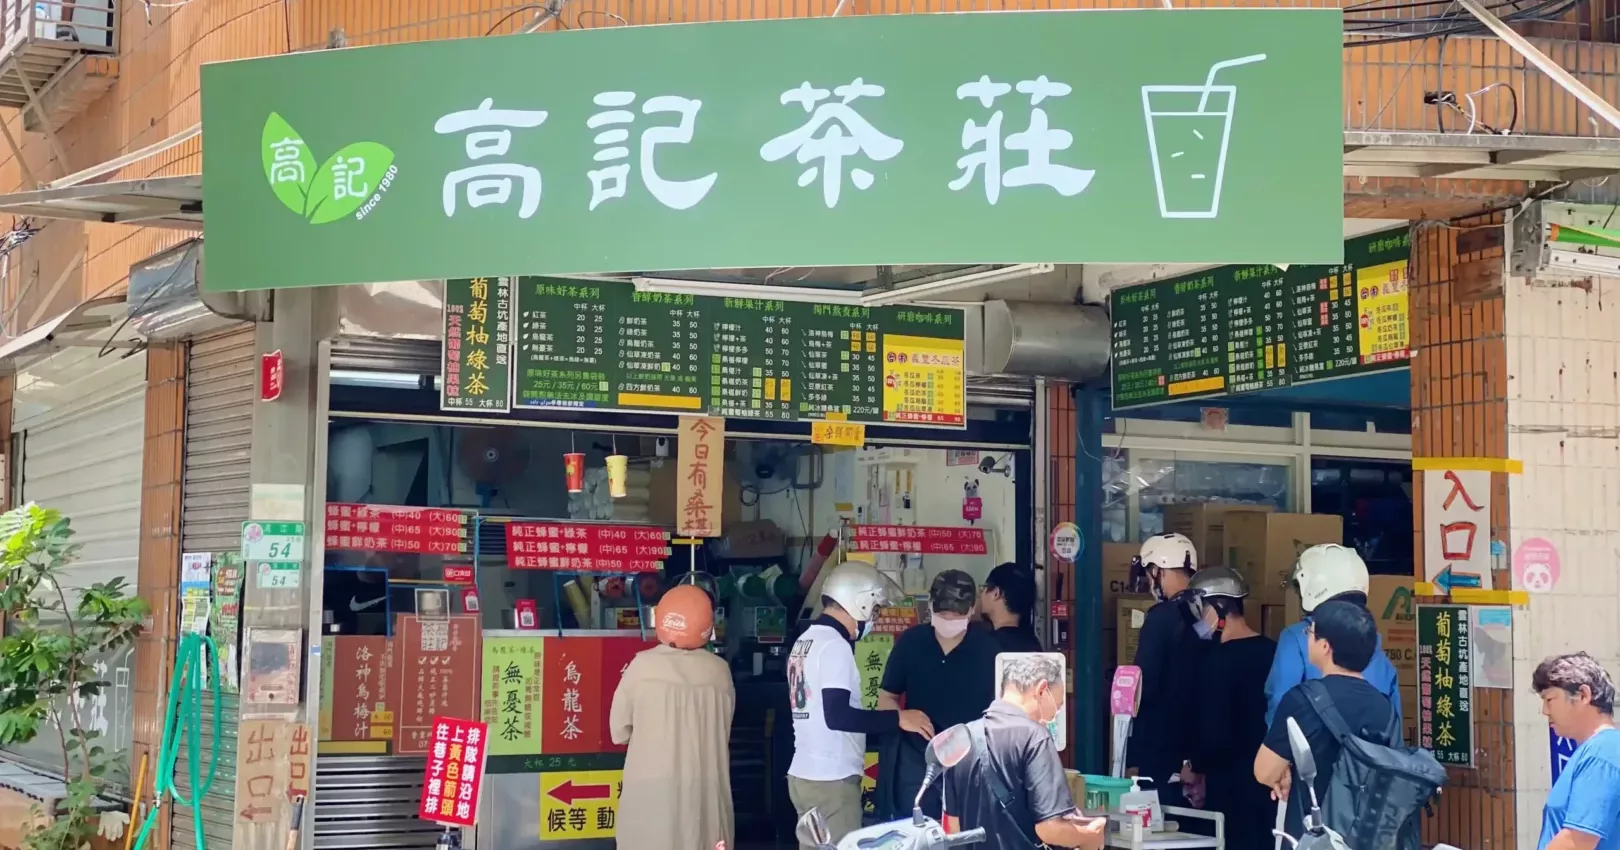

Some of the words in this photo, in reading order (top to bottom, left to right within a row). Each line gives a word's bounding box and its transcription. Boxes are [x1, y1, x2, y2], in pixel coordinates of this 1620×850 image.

[434, 75, 1096, 220] 高記茶莊
[355, 192, 381, 220] since
[379, 165, 398, 193] 1980
[536, 284, 600, 298] 原味好茶系列
[592, 304, 605, 312] 大杯
[687, 310, 700, 318] 大杯
[464, 277, 490, 395] 葡萄柚綠茶
[465, 398, 473, 406] 55
[479, 400, 493, 408] 大杯
[1440, 470, 1484, 560] 入口
[392, 525, 420, 534] (中)65
[429, 526, 457, 536] (大)90
[598, 529, 626, 539] (中)40
[929, 530, 951, 538] (中)50
[269, 542, 291, 558] 54
[391, 540, 419, 549] (中)50
[428, 541, 457, 551] (大)70
[600, 545, 627, 554] (中)65
[636, 546, 663, 555] (大)90
[931, 543, 954, 551] (中)65
[515, 556, 592, 568] 純正蜂蜜鮮奶茶
[596, 559, 621, 568] (中)50
[630, 560, 655, 569] (大)70
[271, 575, 286, 586] 54
[1457, 610, 1469, 712] 雲林古坑產地直送
[1435, 611, 1456, 747] 葡萄柚綠茶
[353, 645, 373, 739] 洛神烏梅汁
[560, 660, 583, 739] 烏龍茶
[500, 661, 523, 741] 無憂茶
[246, 723, 275, 797] 出口
[290, 725, 308, 779] 出口
[1437, 750, 1444, 759] 55
[1448, 751, 1459, 761] 大杯
[424, 723, 449, 814] 往巷子裡排
[549, 757, 560, 767] 25
[440, 725, 464, 816] 上黃色箭頭
[456, 727, 480, 819] 排隊請沿地
